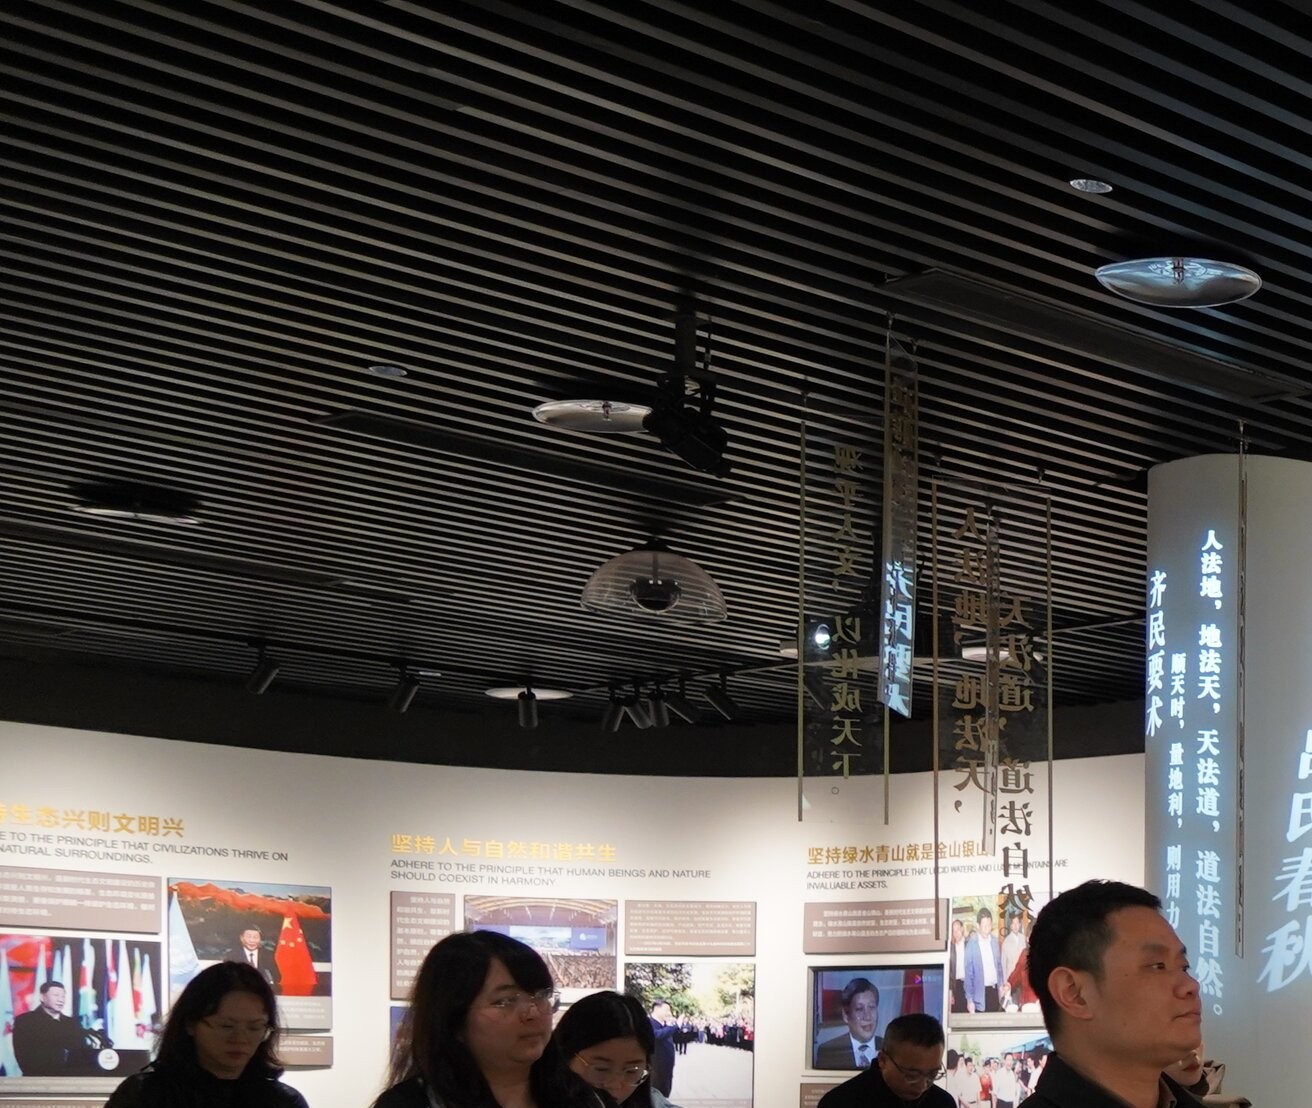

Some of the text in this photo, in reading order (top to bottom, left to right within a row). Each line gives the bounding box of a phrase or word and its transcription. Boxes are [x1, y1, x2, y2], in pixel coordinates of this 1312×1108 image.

[1146, 570, 1168, 738] 齐民要术
[10, 832, 26, 842] TO
[31, 833, 54, 844] THE
[57, 835, 118, 849] PRINCIPLE
[122, 840, 150, 852] THAT
[152, 843, 229, 858] CIVILIZATIONS
[232, 848, 269, 861] THRIVE
[272, 851, 288, 861] ON
[390, 833, 617, 863] 坚持人与自然和谐共生
[390, 859, 711, 879] ADHERE TO THE PRINCIPLE THAT HUMAN BEINGS AND NATURE
[390, 871, 436, 882] SHOULD
[438, 873, 484, 884] COEXIST
[488, 874, 498, 884] IN
[807, 869, 840, 879] ADHERE
[842, 869, 853, 878] TO
[855, 869, 869, 878] THE
[871, 868, 910, 878] PRINCIPLE
[911, 867, 927, 876] THAT
[807, 880, 855, 889] INVALUABLE
